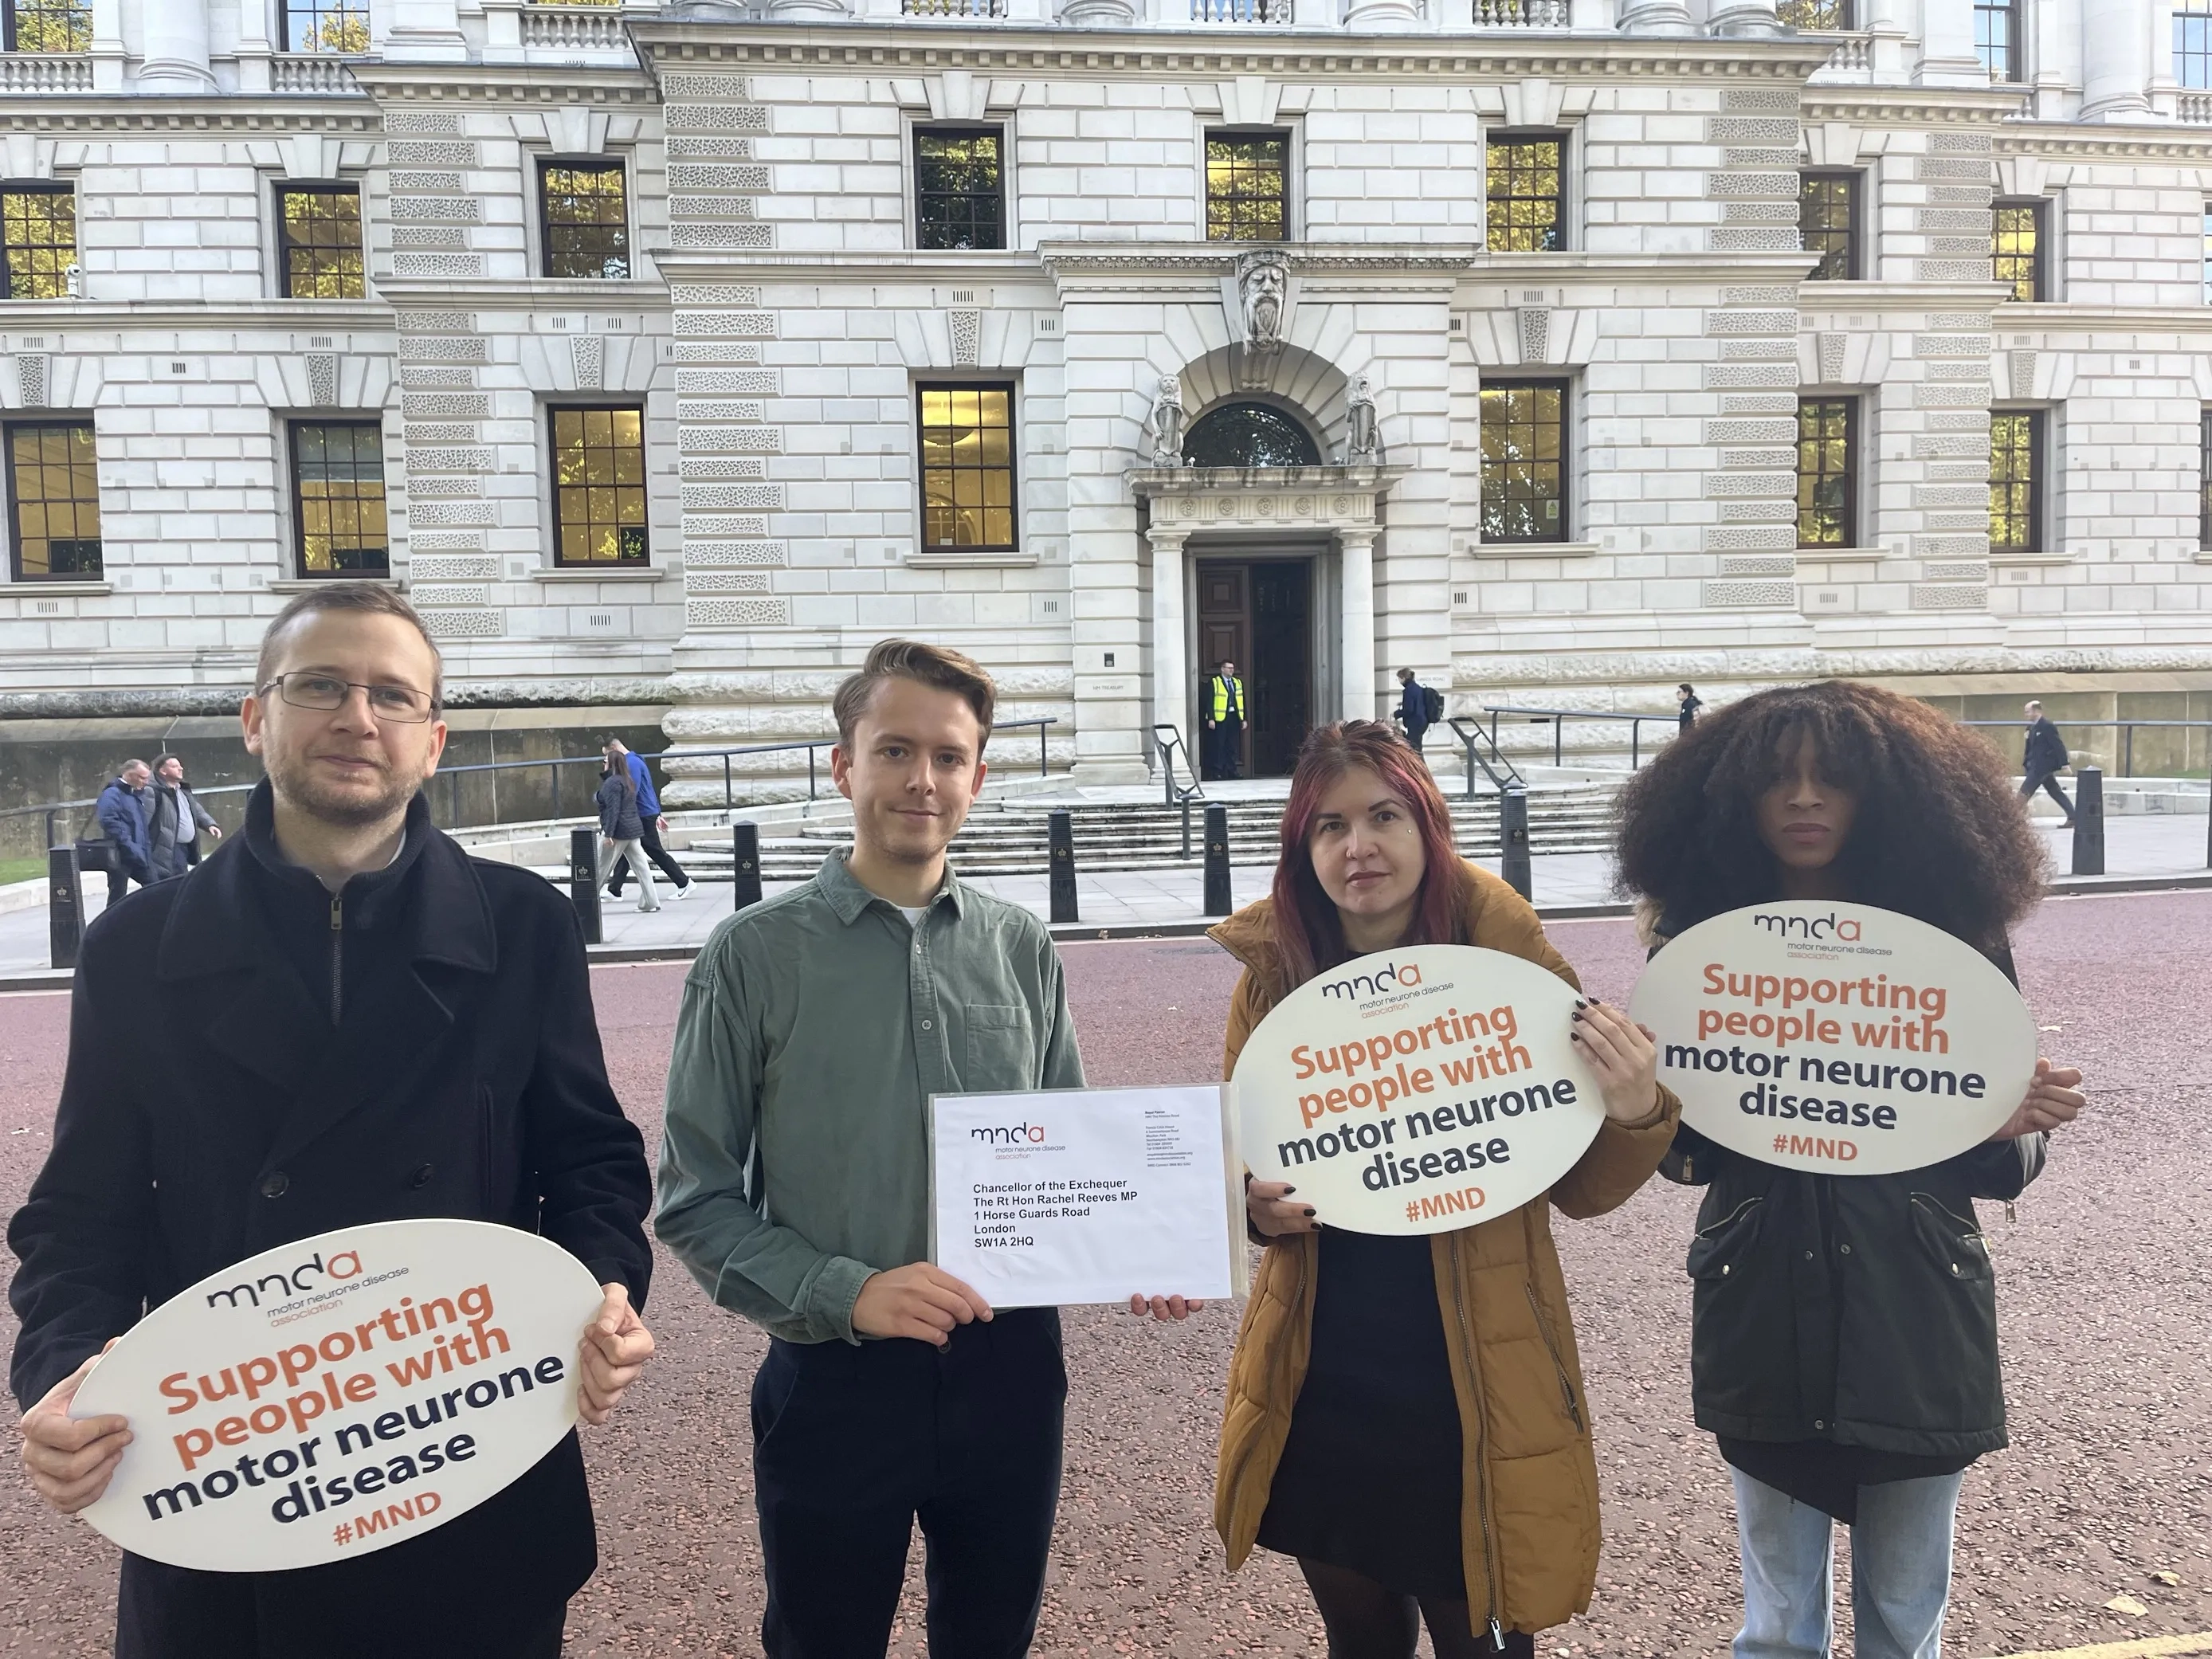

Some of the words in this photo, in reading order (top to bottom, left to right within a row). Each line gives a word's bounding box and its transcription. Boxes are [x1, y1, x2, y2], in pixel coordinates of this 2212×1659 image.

[1755, 913, 1861, 941] mnda
[1786, 951, 1839, 961] association
[1815, 944, 1855, 953] neurone
[1856, 946, 1892, 955] disease
[1322, 963, 1422, 1000] mnda
[1359, 998, 1384, 1010] motor
[1385, 990, 1420, 1004] neurone
[1422, 982, 1453, 995] disease
[1702, 963, 1947, 1020] Supporting
[1361, 1002, 1409, 1018] association
[1291, 1006, 1517, 1079] Supporting
[1697, 1009, 1841, 1048] people
[1852, 1015, 1948, 1054] with
[1299, 1063, 1434, 1128] people
[1439, 1040, 1532, 1087] with
[1665, 1044, 1790, 1078] motor
[1799, 1057, 1986, 1100] neurone
[1277, 1117, 1396, 1167] motor
[1406, 1078, 1578, 1139] neurone
[1739, 1084, 1897, 1130] disease
[971, 1122, 1044, 1144] mnda
[1772, 1134, 1858, 1162] #MND
[1362, 1138, 1511, 1190] disease
[974, 1182, 1032, 1194] Chancellor
[1034, 1181, 1046, 1190] of
[1049, 1181, 1066, 1190] the
[1069, 1179, 1128, 1190] Exchequer
[974, 1197, 994, 1206] The
[997, 1197, 1009, 1206] Rt
[1012, 1195, 1034, 1206] Hon
[1037, 1194, 1074, 1204] Rachel
[1078, 1193, 1117, 1203] Reeves
[1120, 1191, 1138, 1202] MP
[1406, 1187, 1485, 1222] #MND
[974, 1211, 979, 1221] 1
[983, 1210, 1015, 1220] Horse
[1018, 1208, 1058, 1218] Guards
[1061, 1206, 1090, 1218] Road
[974, 1224, 1016, 1234] London
[974, 1237, 1007, 1248] SW1A
[1010, 1237, 1034, 1246] 2HQ
[207, 1250, 363, 1308] mnda
[267, 1299, 305, 1318] motor
[308, 1282, 359, 1305] neurone
[362, 1266, 410, 1288] disease
[271, 1299, 343, 1328] association
[159, 1283, 494, 1415] Supporting
[172, 1371, 378, 1472] people
[385, 1324, 511, 1388] with
[142, 1437, 321, 1521] motor
[335, 1356, 564, 1457] neurone
[271, 1433, 477, 1524] disease
[333, 1492, 441, 1547] #MND
